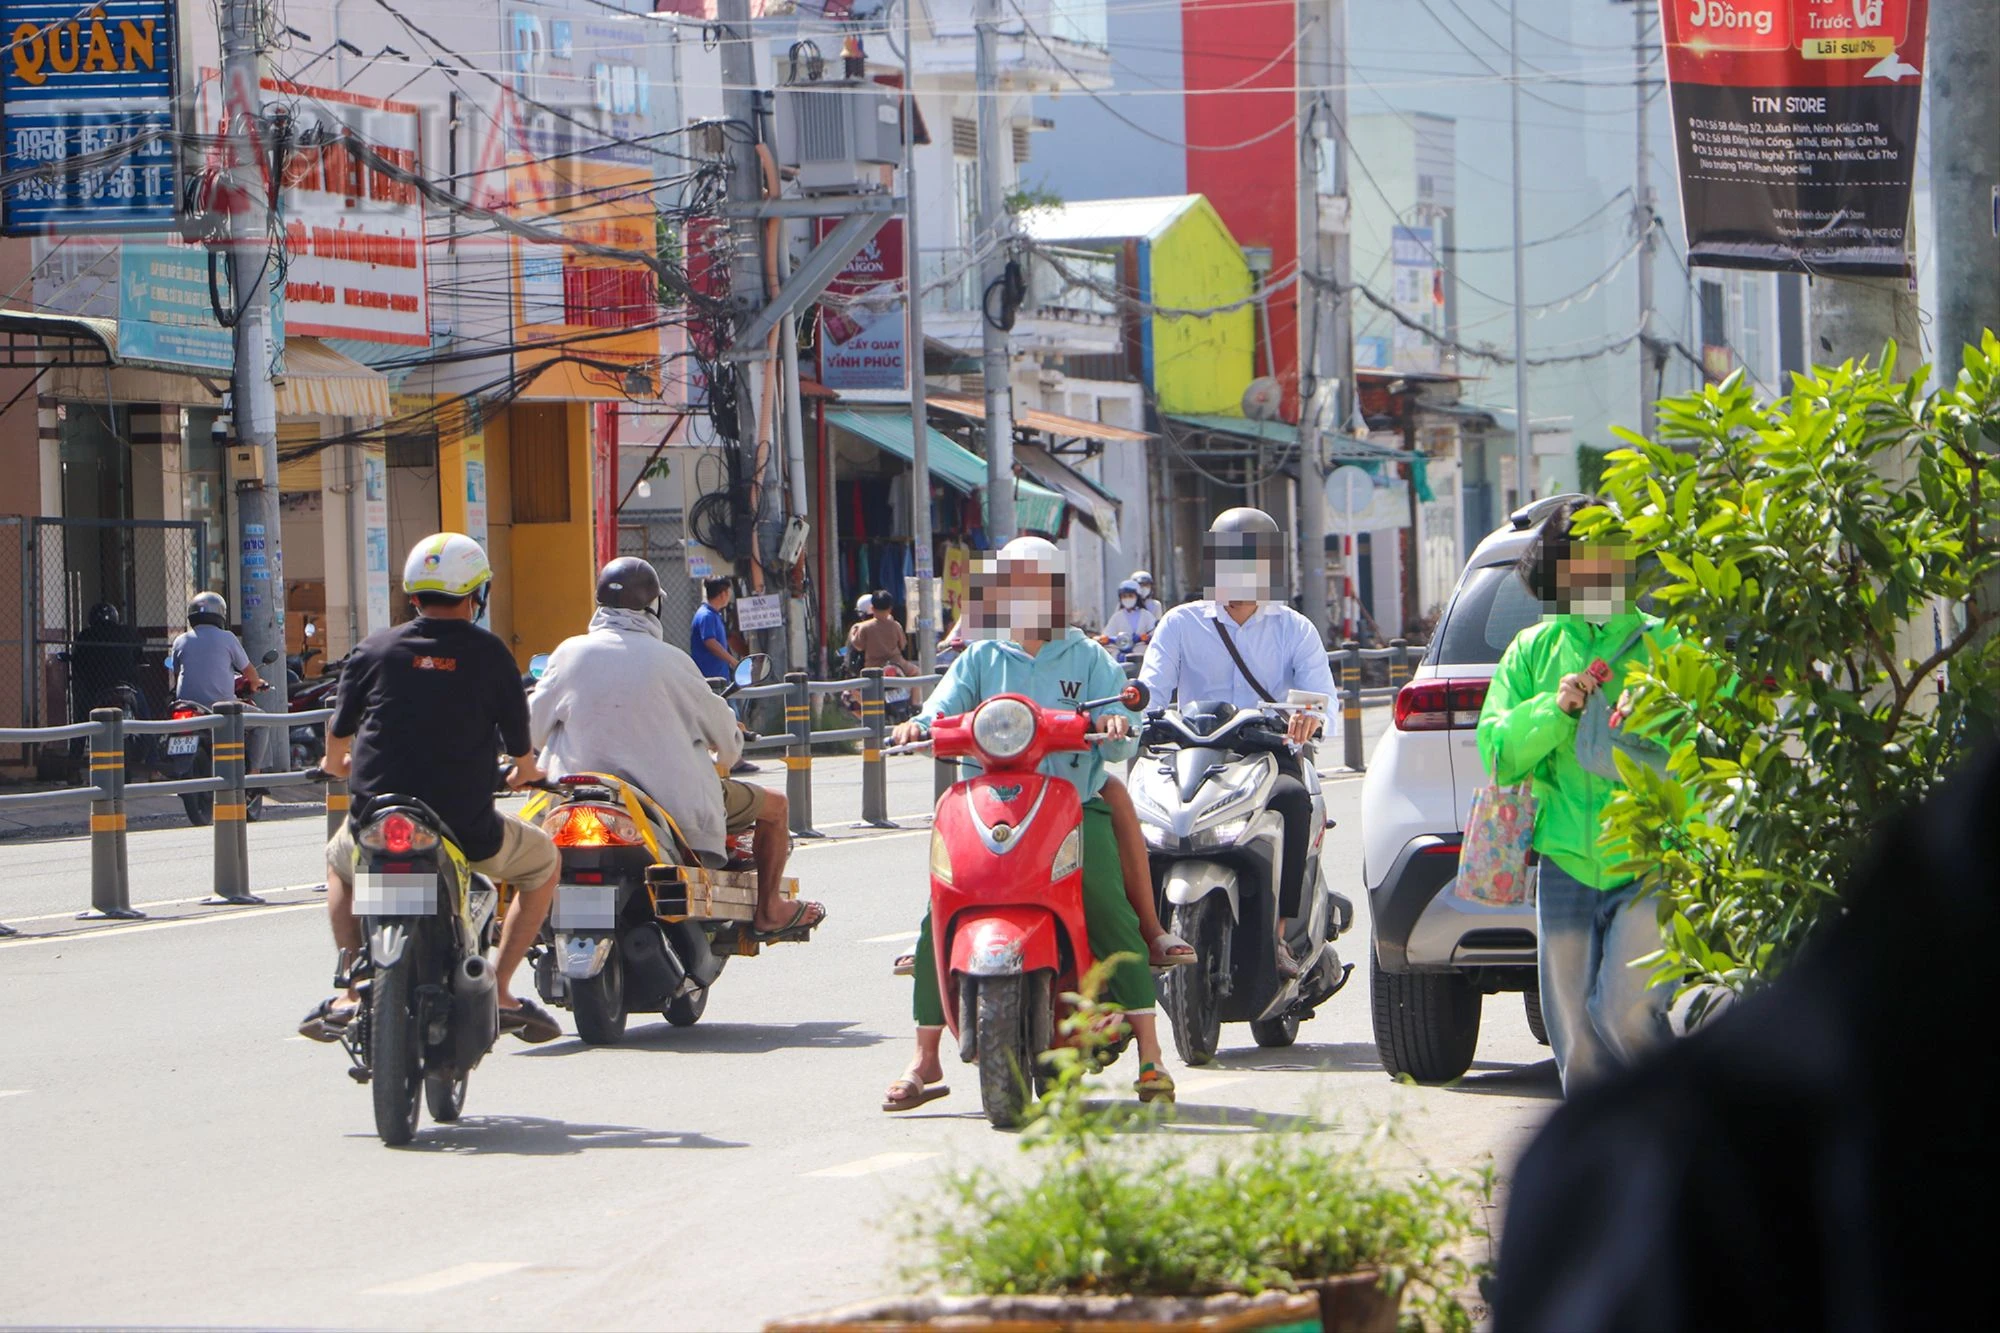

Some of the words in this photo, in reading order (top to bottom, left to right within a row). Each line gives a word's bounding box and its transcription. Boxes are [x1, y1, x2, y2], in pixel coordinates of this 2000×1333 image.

[1708, 0, 1773, 35] Đồng
[1808, 12, 1853, 29] Trước
[1817, 40, 1837, 54] Lãi
[1861, 40, 1876, 53] 0%
[1785, 96, 1827, 113] STORE
[1813, 122, 1834, 133] Ninh
[1772, 163, 1799, 176] Ngọc
[871, 340, 899, 350] QUAY
[863, 352, 902, 368] PHÚC
[1059, 680, 1082, 699] W
